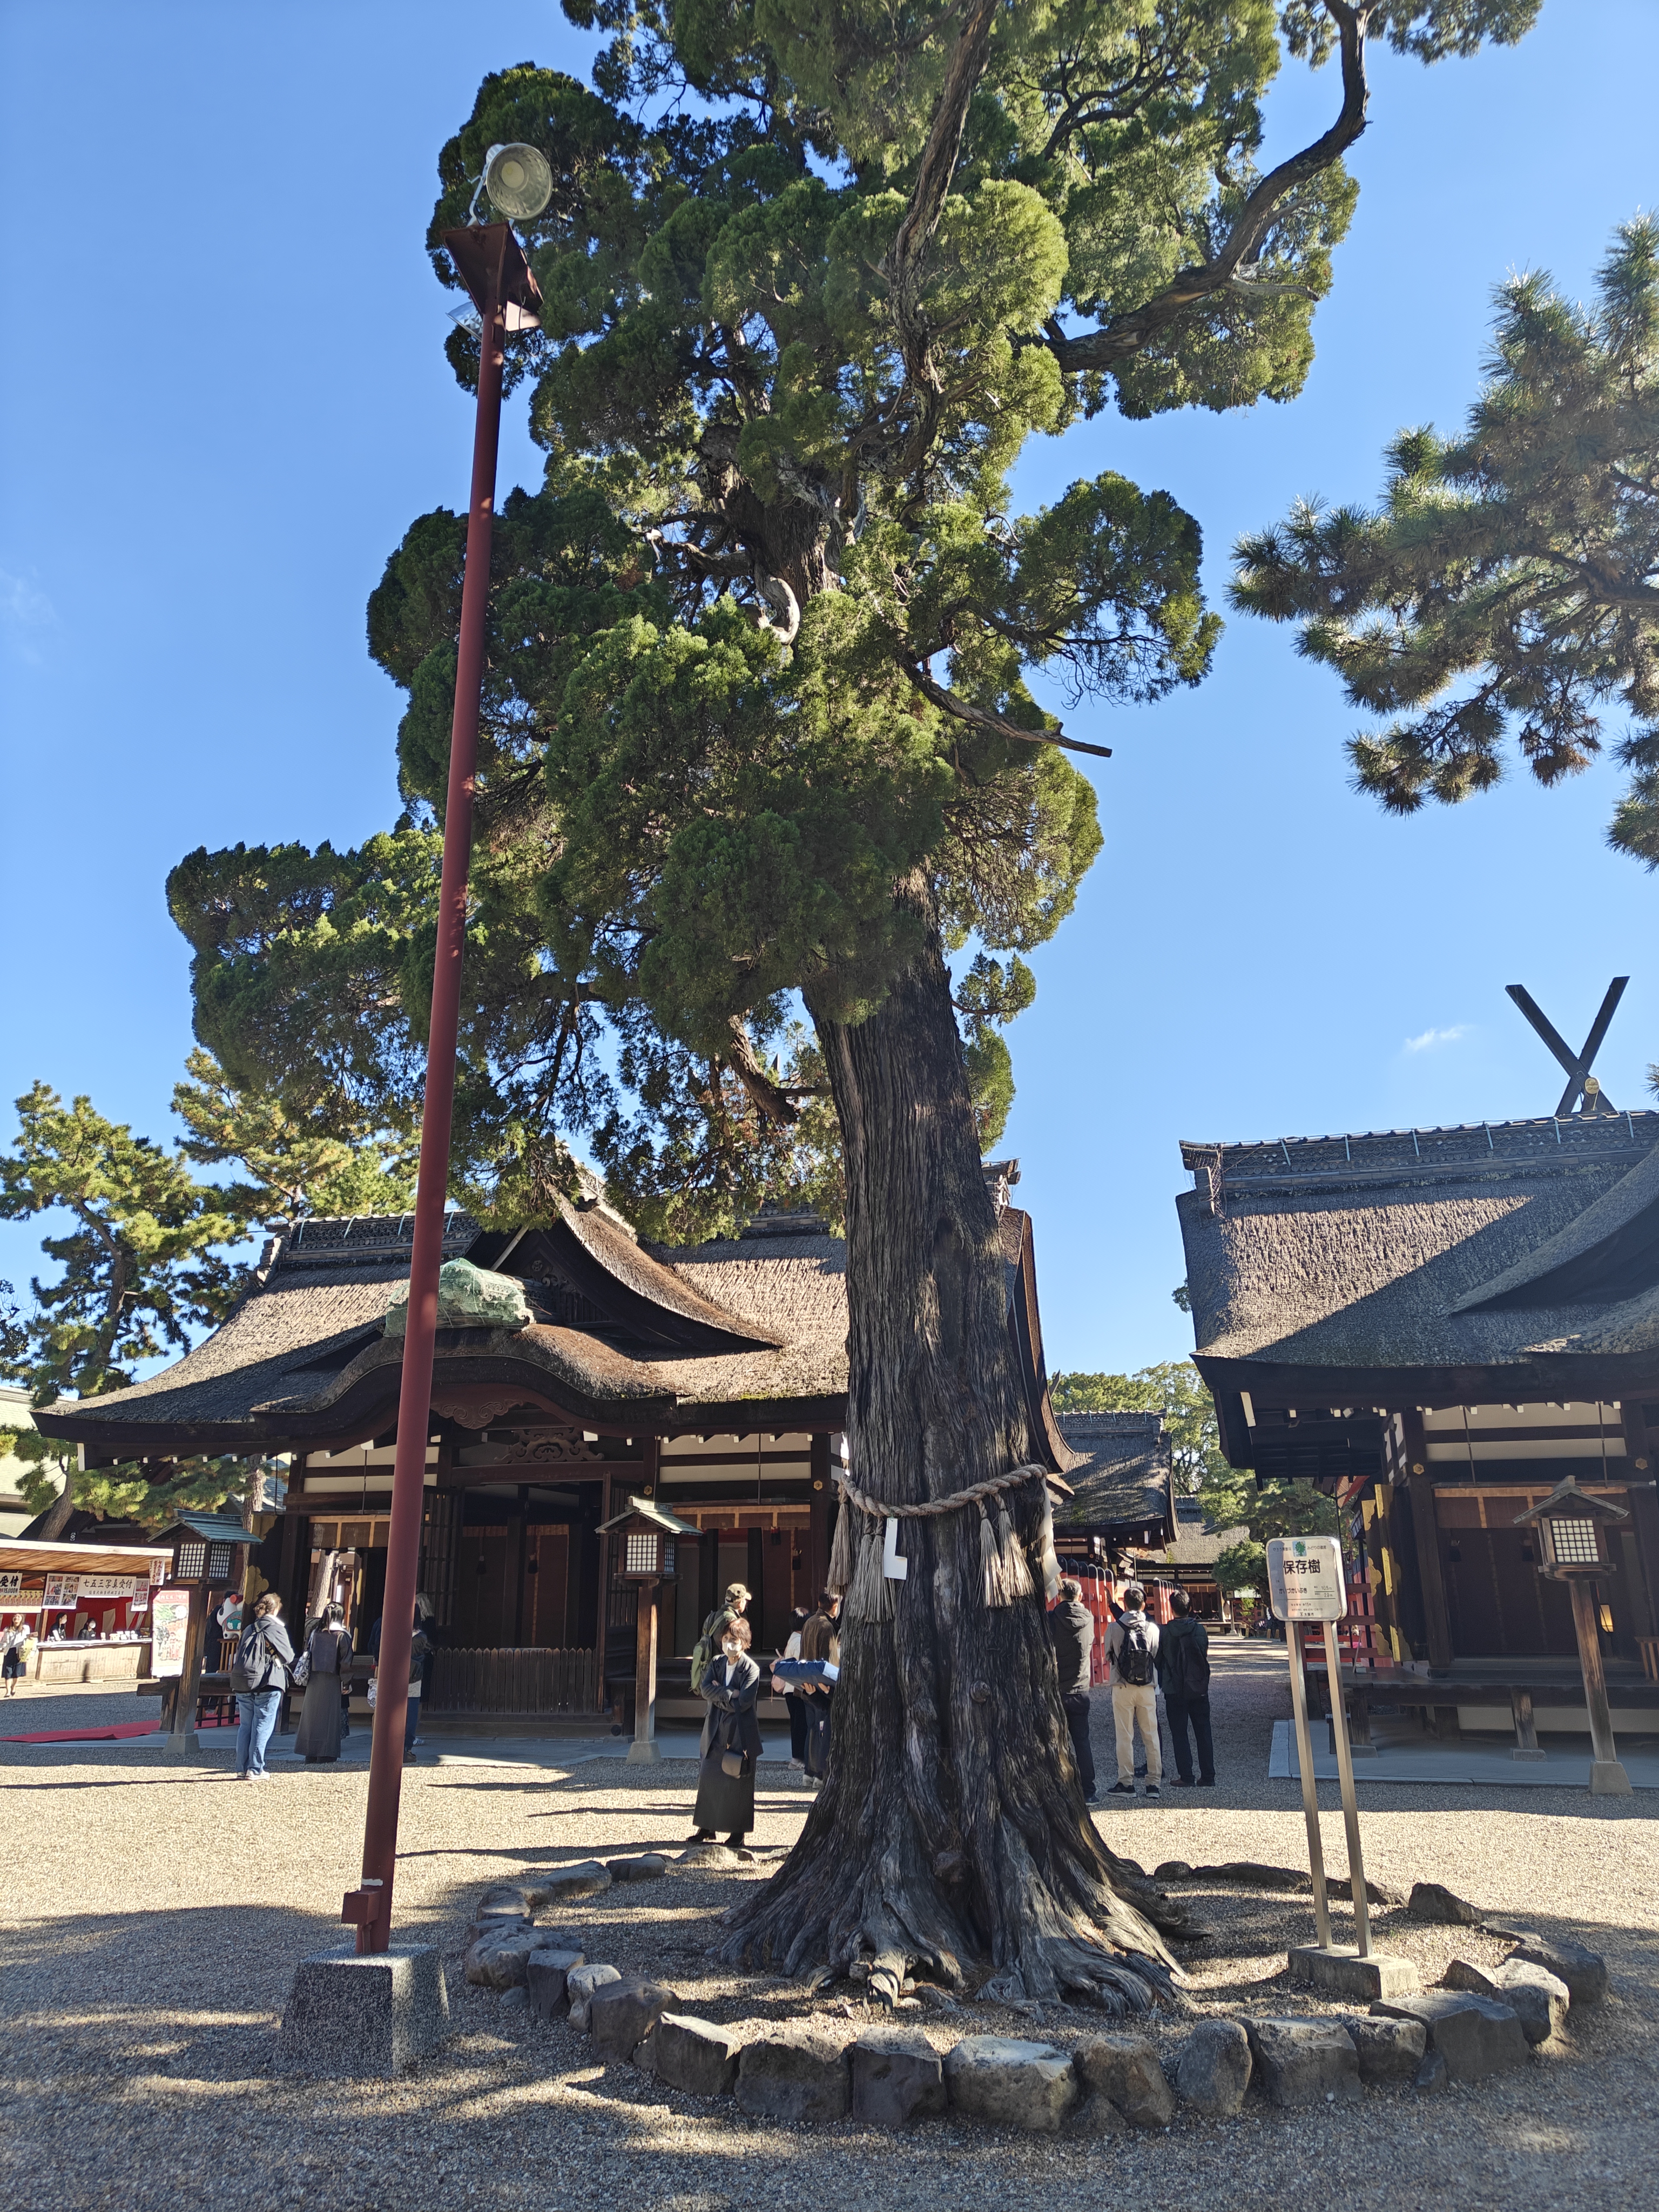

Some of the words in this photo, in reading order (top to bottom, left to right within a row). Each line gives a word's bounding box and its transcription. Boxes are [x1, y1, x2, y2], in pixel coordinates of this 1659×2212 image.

[1283, 1559, 1320, 1575] 保存樹
[0, 1575, 19, 1587] 受付
[83, 1578, 132, 1589] 七五三写真受付
